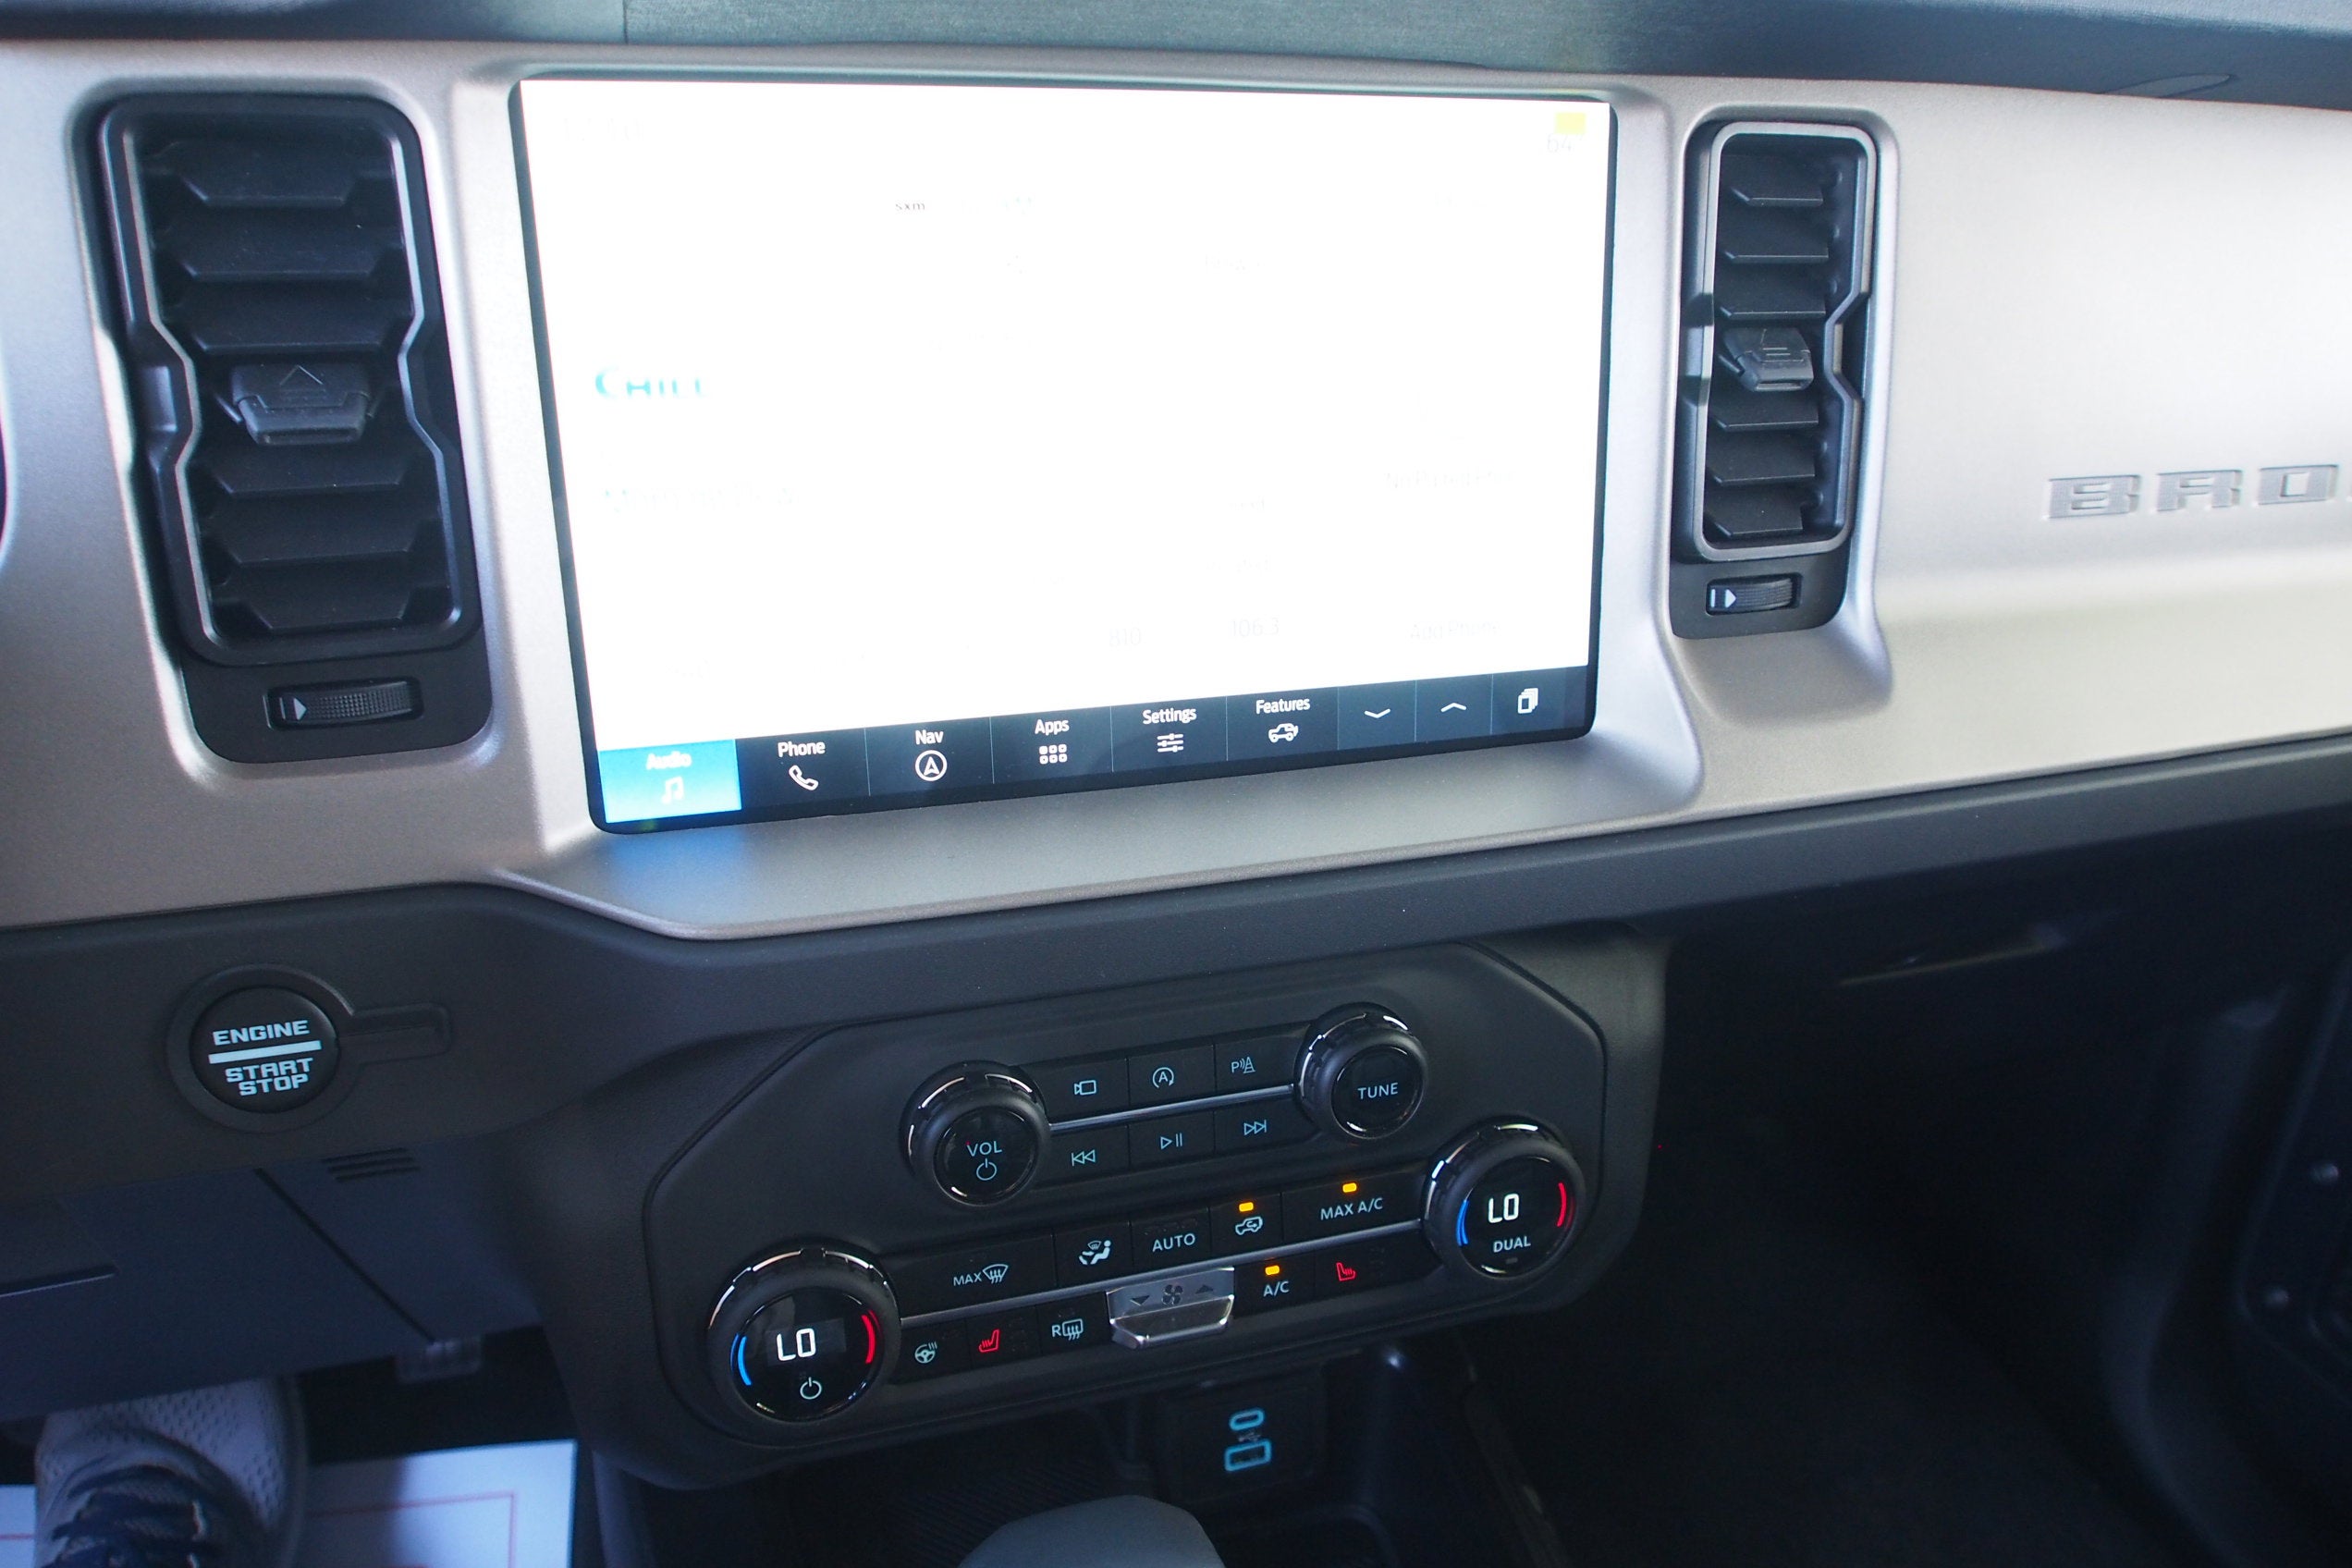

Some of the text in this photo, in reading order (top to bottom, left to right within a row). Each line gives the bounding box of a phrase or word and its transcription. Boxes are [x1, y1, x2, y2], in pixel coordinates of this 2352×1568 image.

[1256, 697, 1311, 715] Features
[1142, 706, 1197, 725] Settings
[1035, 718, 1070, 736] Apps
[915, 729, 943, 745] Nav
[778, 741, 826, 757] Phone
[645, 751, 692, 770] Audio
[213, 1020, 311, 1046] ENGINE
[225, 1058, 313, 1083] START
[238, 1073, 309, 1096] STOP
[1357, 1082, 1399, 1100] TUNE
[967, 1141, 1002, 1158] VOL
[1320, 1198, 1384, 1221] MAX A/C
[1488, 1194, 1521, 1223] LO
[1152, 1232, 1196, 1253] AUTO
[1493, 1235, 1531, 1253] DUAL
[953, 1272, 982, 1287] MAX
[1263, 1280, 1291, 1297] A/C
[777, 1328, 816, 1362] LO
